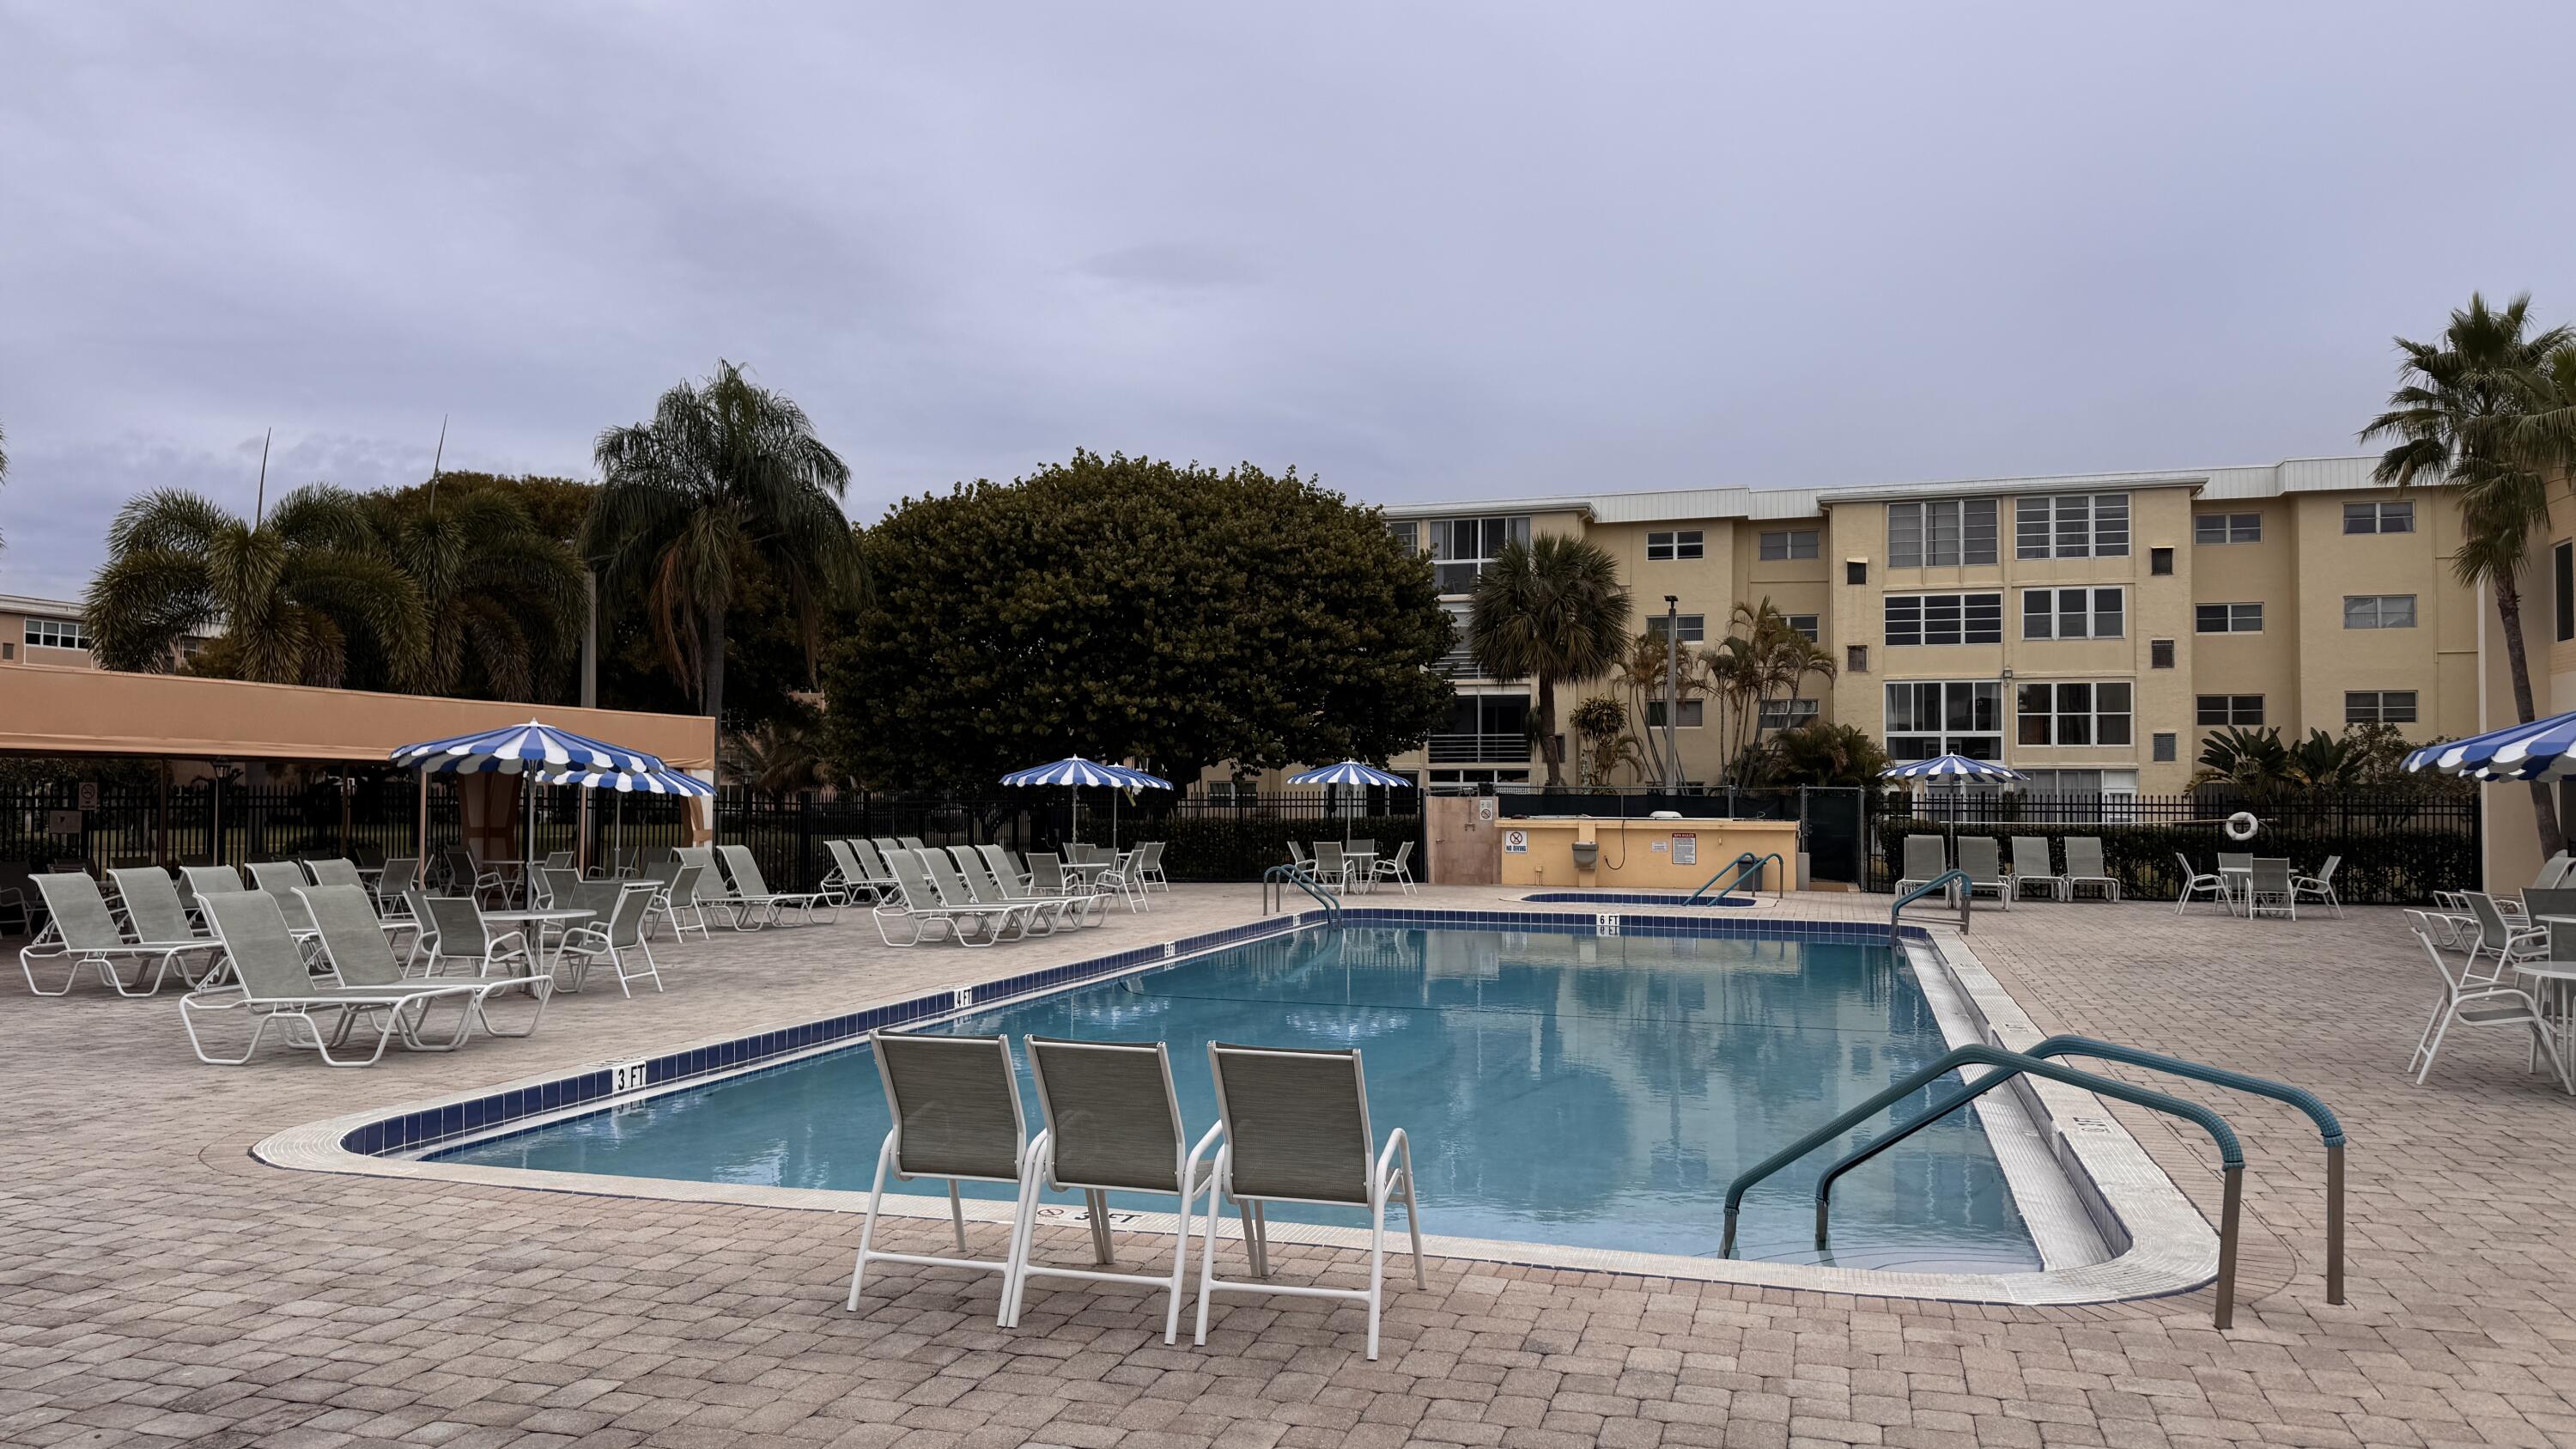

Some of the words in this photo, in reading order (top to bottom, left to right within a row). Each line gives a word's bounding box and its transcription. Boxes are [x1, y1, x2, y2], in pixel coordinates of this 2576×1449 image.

[1600, 916, 1605, 925] 6
[1608, 916, 1619, 925] FT
[957, 990, 961, 1007] 4
[963, 989, 971, 1006] FT
[617, 1068, 625, 1090] 3
[630, 1063, 646, 1088] FT
